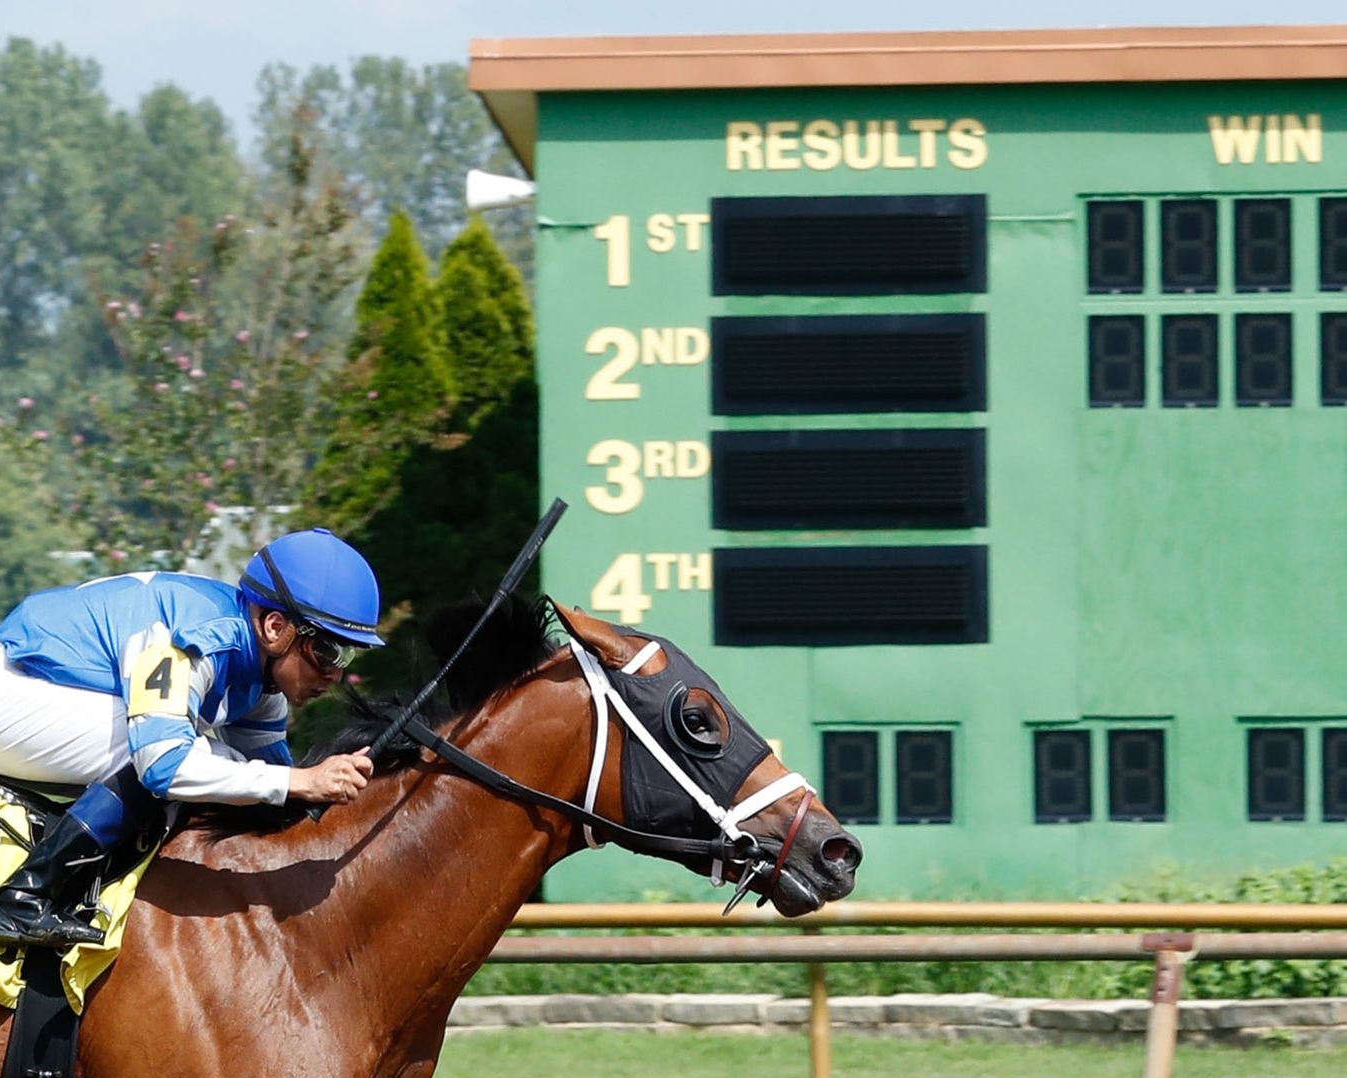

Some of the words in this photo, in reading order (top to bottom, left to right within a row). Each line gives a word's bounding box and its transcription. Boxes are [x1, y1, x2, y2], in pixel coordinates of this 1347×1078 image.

[726, 119, 988, 170] RESULTS
[1209, 115, 1323, 164] WIN
[585, 327, 711, 401] 2ND
[585, 440, 712, 515] 3RD
[591, 553, 713, 624] 4TH
[145, 657, 173, 699] 4
